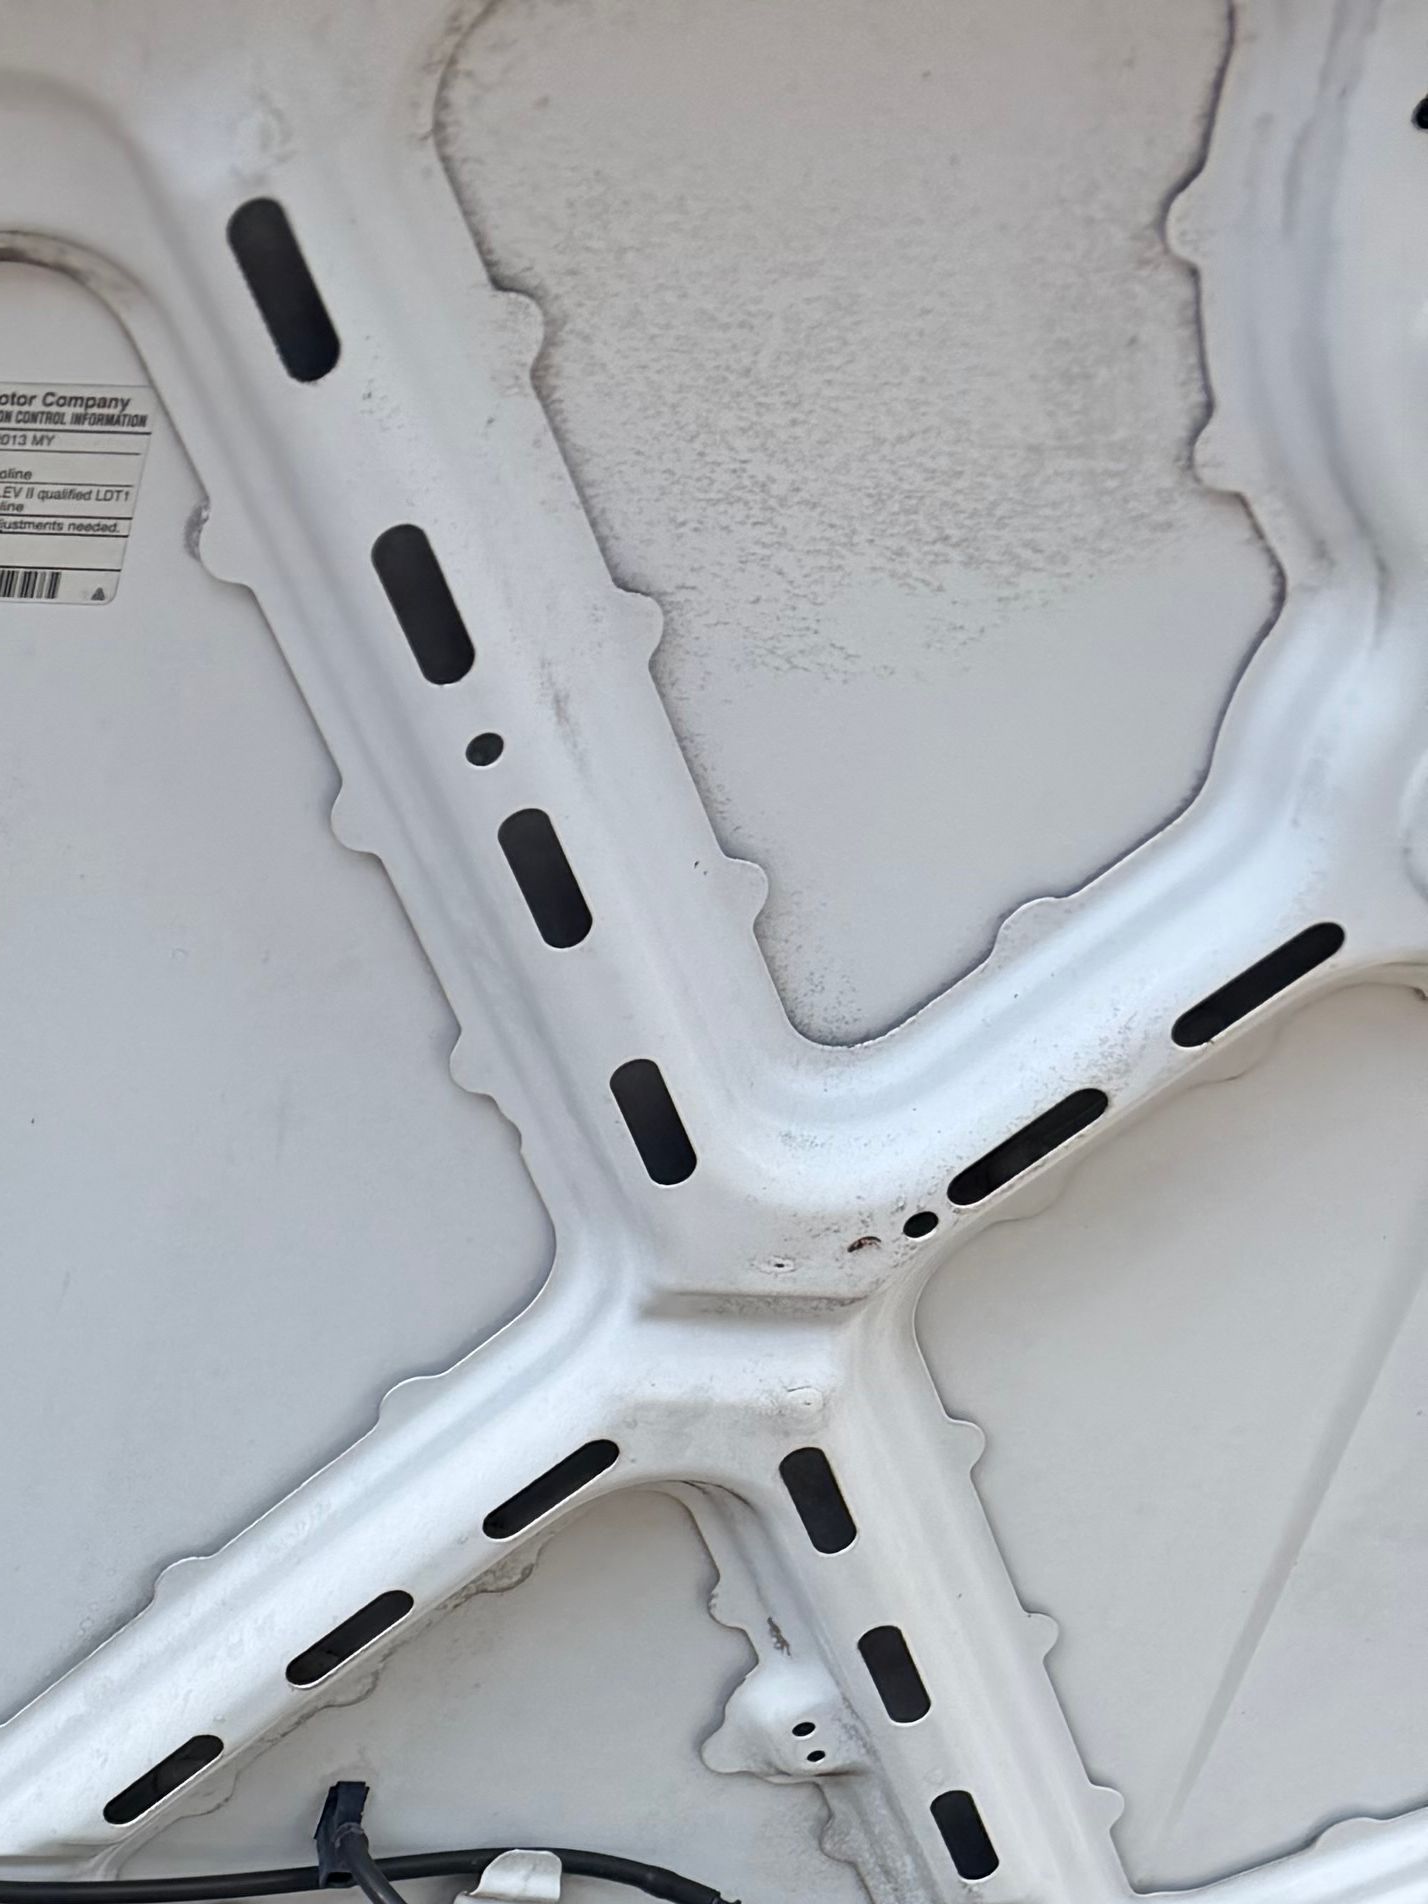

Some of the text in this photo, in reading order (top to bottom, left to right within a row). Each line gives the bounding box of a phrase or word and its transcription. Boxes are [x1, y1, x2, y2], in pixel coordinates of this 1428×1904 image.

[42, 391, 132, 413] Company
[15, 411, 66, 426] CONTROL
[70, 412, 148, 428] INFORMATION
[31, 434, 55, 447] MY
[25, 487, 35, 499] II
[37, 487, 93, 501] qualified
[95, 489, 130, 502] LDT1
[67, 521, 121, 533] needed.
